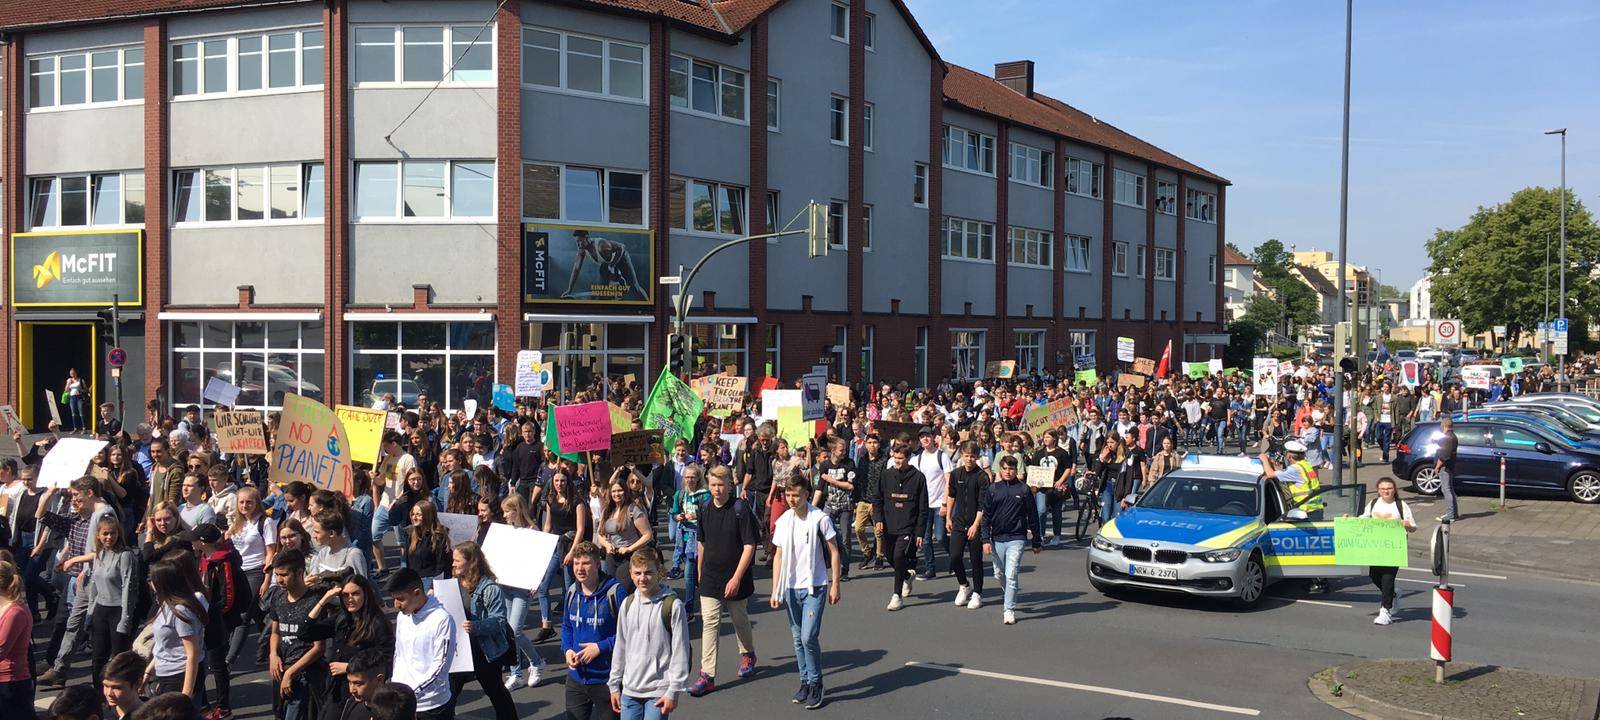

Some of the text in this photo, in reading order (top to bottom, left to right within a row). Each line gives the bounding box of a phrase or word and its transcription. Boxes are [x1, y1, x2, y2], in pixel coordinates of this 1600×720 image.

[62, 253, 117, 273] McFIT
[81, 277, 90, 285] gut
[1441, 325, 1452, 334] 30
[1557, 320, 1565, 329] P
[715, 377, 738, 388] KEEP
[215, 412, 233, 428] WIR
[1028, 415, 1049, 428] NICHT
[288, 421, 313, 444] NO
[278, 443, 353, 500] PLANET B
[1136, 519, 1203, 531] POLIZEI
[1134, 566, 1147, 575] NRW
